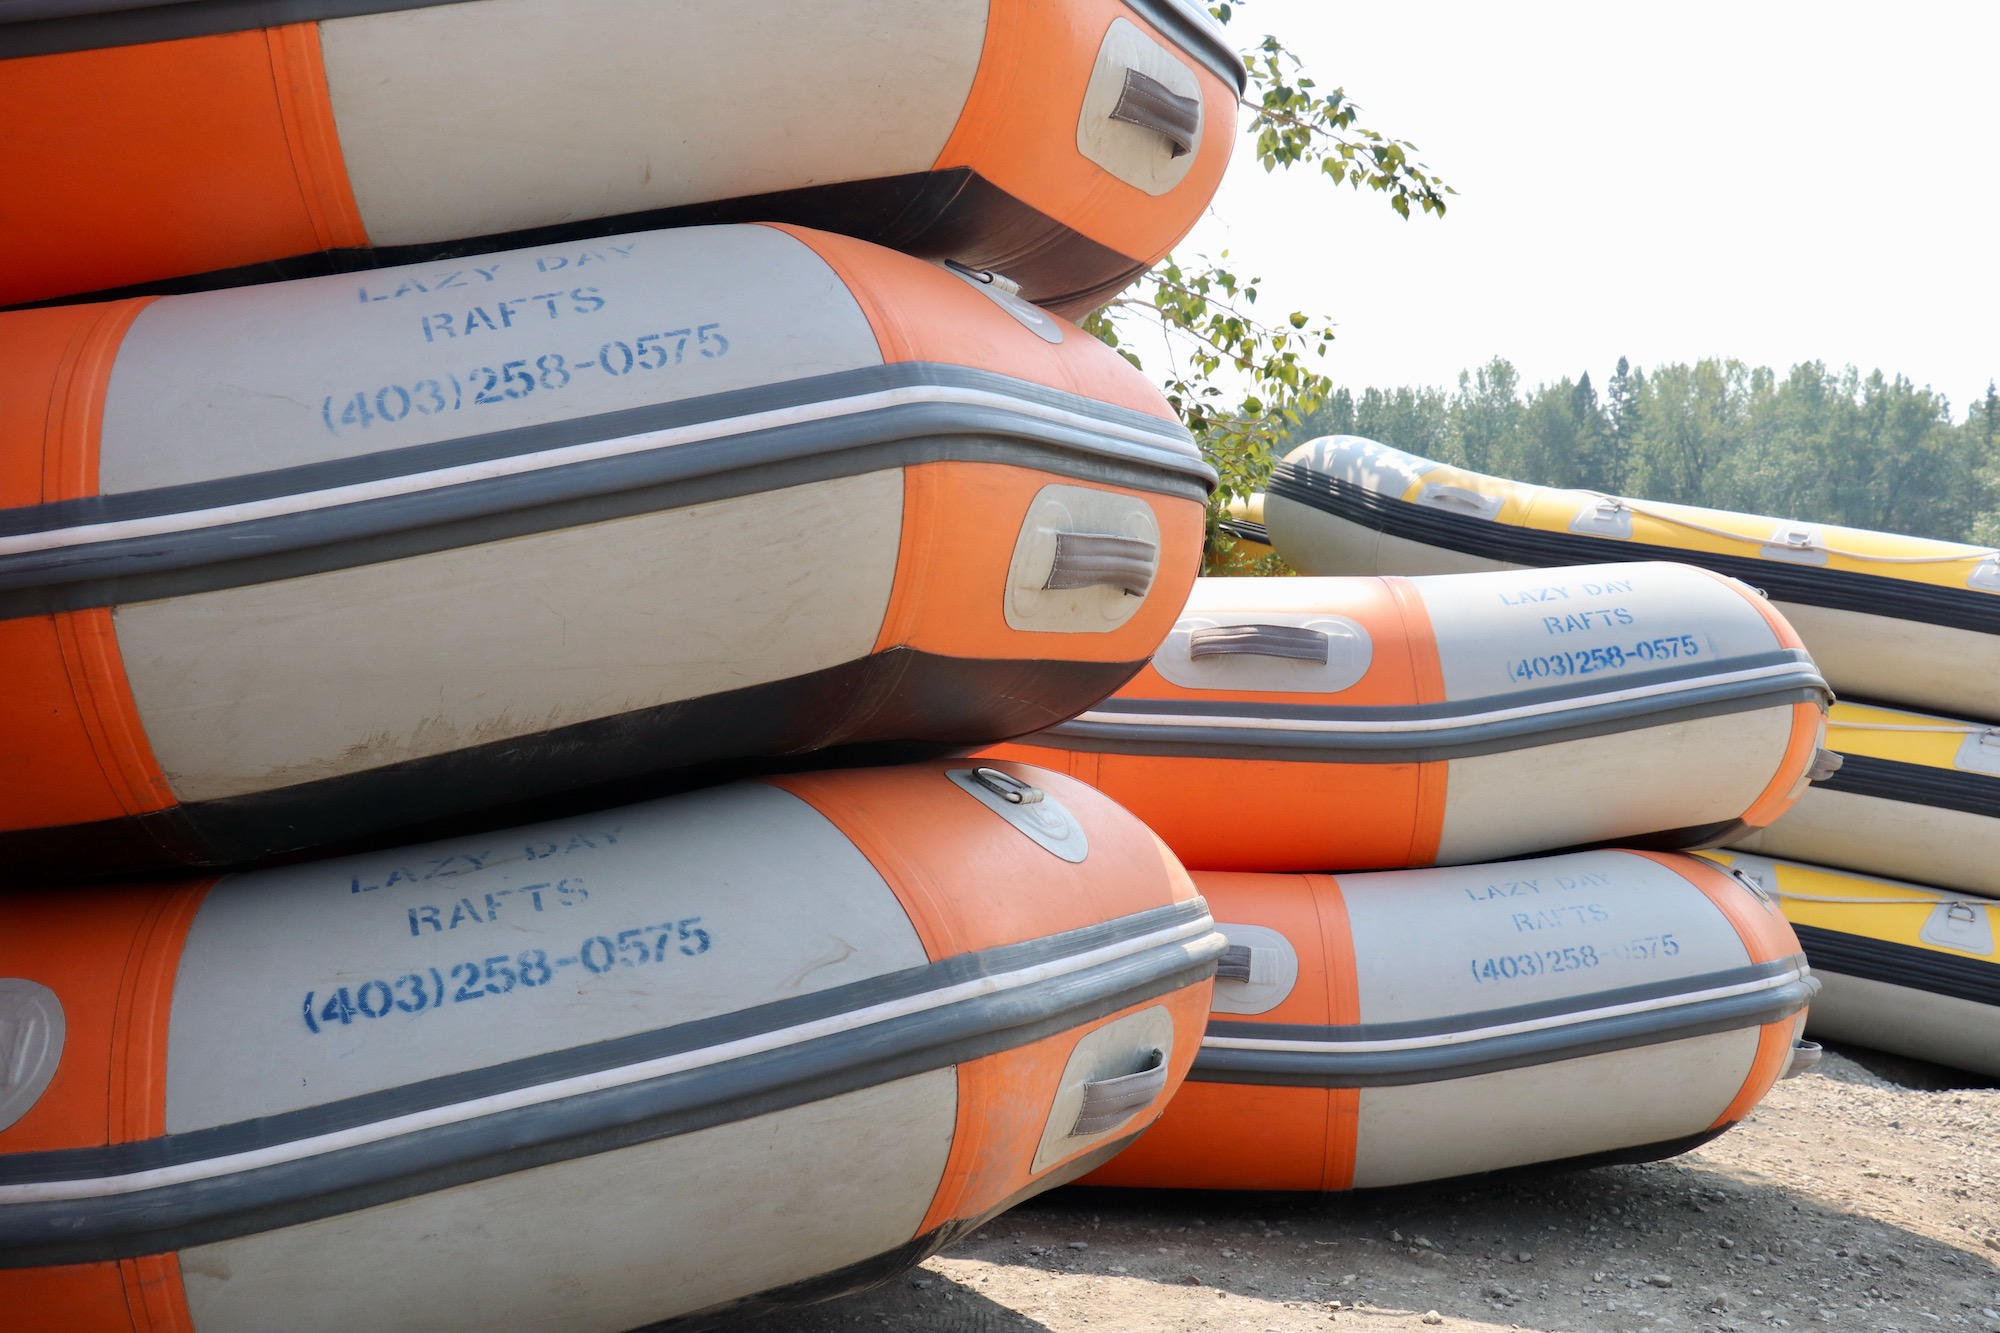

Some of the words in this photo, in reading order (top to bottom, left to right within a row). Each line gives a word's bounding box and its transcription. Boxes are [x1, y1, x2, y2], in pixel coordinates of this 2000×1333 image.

[359, 265, 499, 303] LAZY
[536, 243, 636, 273] DAY
[421, 287, 606, 343] RAFTS
[321, 323, 729, 436] (403)258-0575
[1497, 586, 1570, 606] LAZY
[1582, 580, 1633, 596] DAY
[1543, 607, 1634, 635] RAFTS
[1507, 634, 1699, 683] (403)258-0575
[350, 850, 491, 894] LAZY
[524, 826, 624, 861] DAY
[1465, 879, 1540, 901] LAZY
[1555, 871, 1611, 891] DAY
[408, 877, 589, 936] RAFTS
[1512, 903, 1610, 932] RAFTS
[303, 916, 711, 1034] (403)258-0575
[1471, 934, 1679, 984] (403)258-0575
